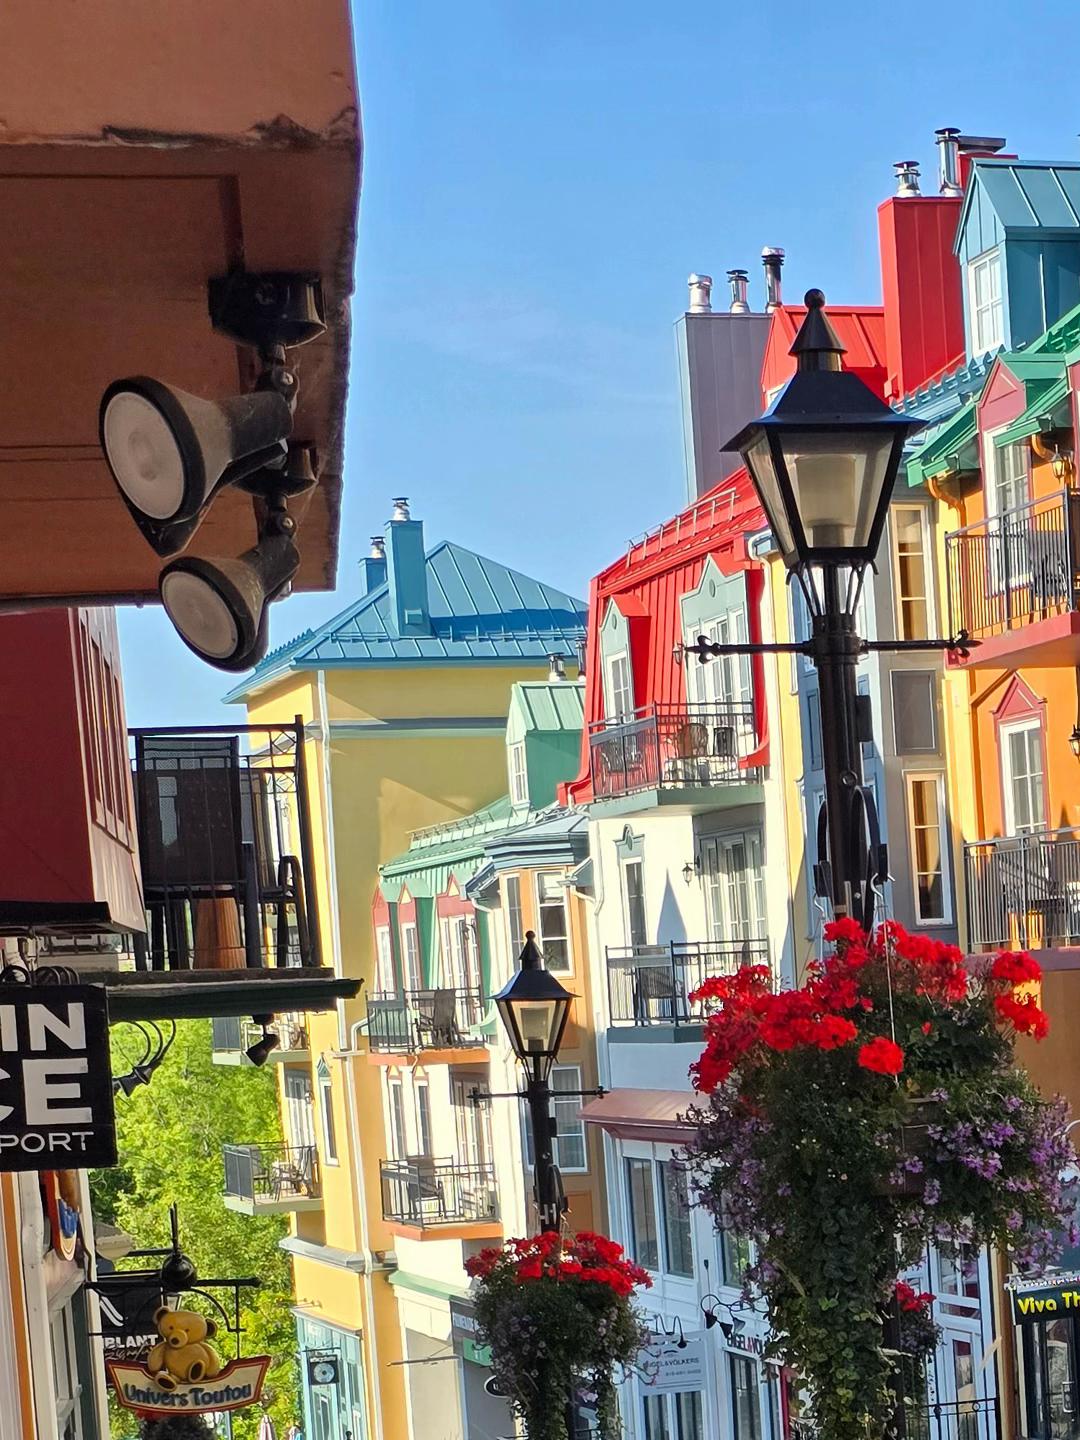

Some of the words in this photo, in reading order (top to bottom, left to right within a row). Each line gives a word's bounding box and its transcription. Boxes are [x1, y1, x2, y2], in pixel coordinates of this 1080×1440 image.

[1018, 1297, 1057, 1315] Viva
[124, 1383, 189, 1407] Univers
[189, 1383, 252, 1406] Toutou
